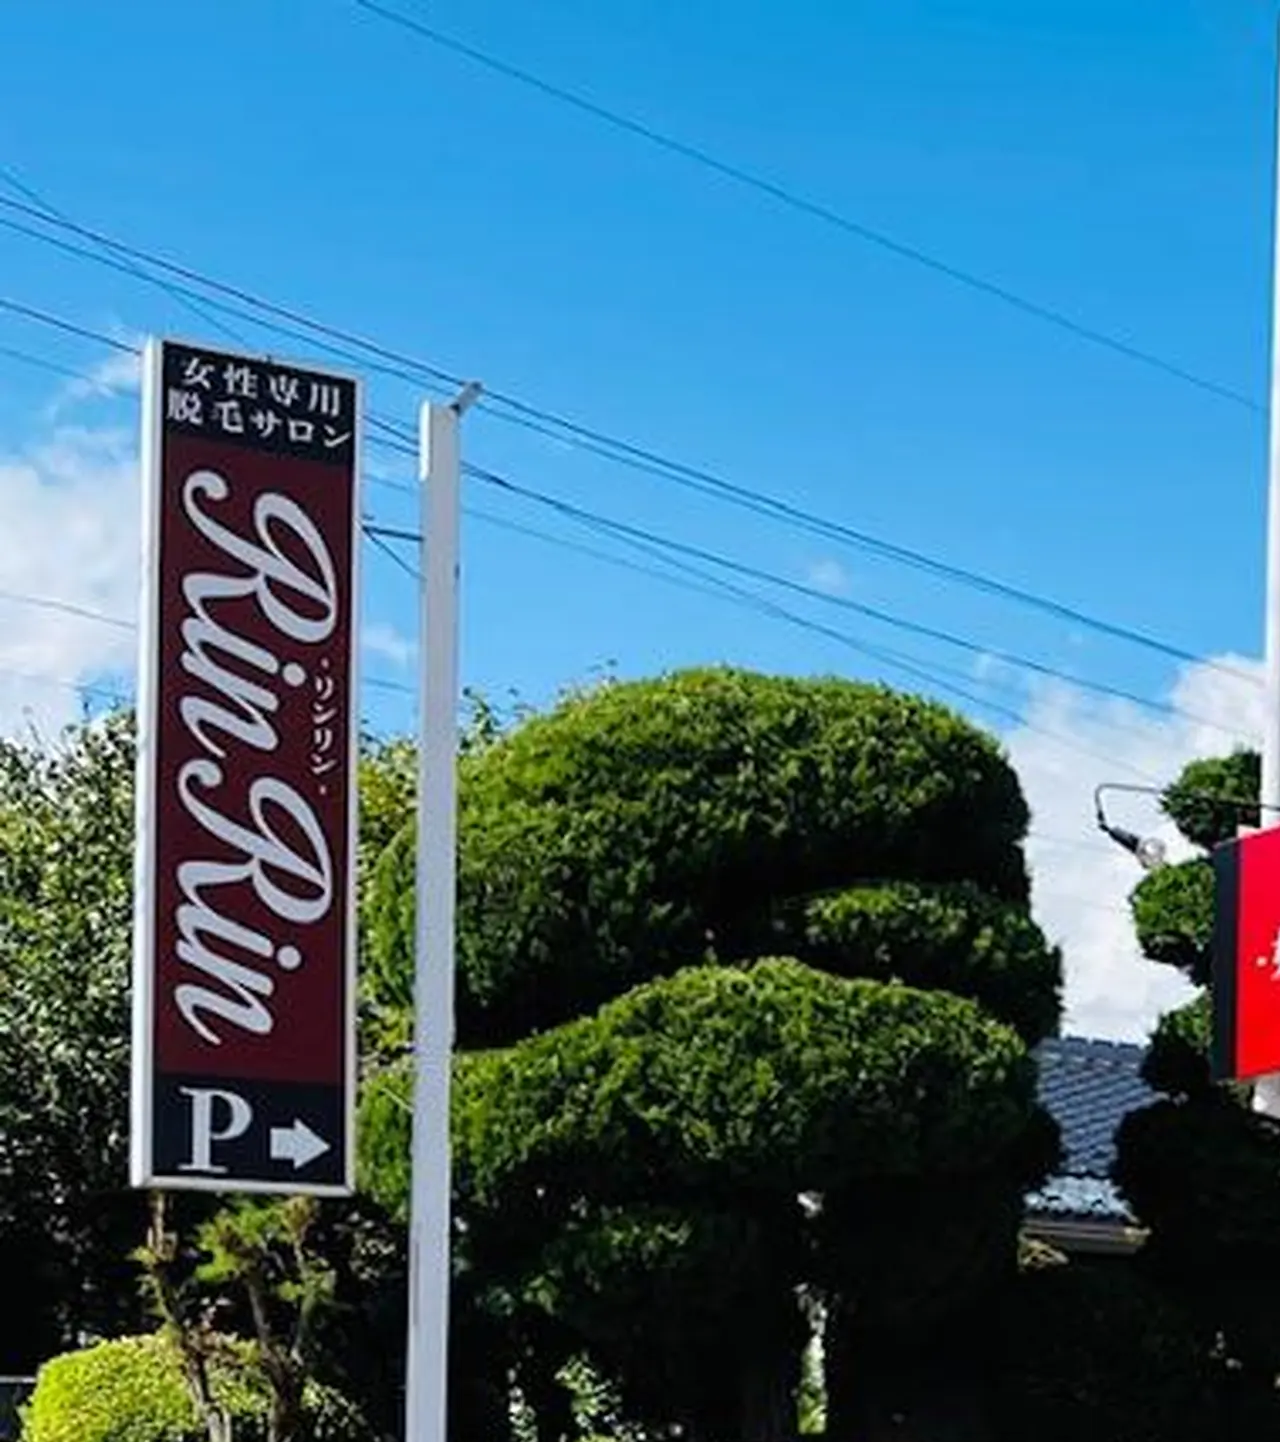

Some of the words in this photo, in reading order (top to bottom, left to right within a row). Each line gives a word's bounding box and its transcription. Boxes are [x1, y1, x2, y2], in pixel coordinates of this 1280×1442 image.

[166, 386, 352, 448] 脱毛サロン
[181, 470, 338, 759] Rin
[174, 759, 333, 1046] Rin
[178, 1086, 252, 1174] P
